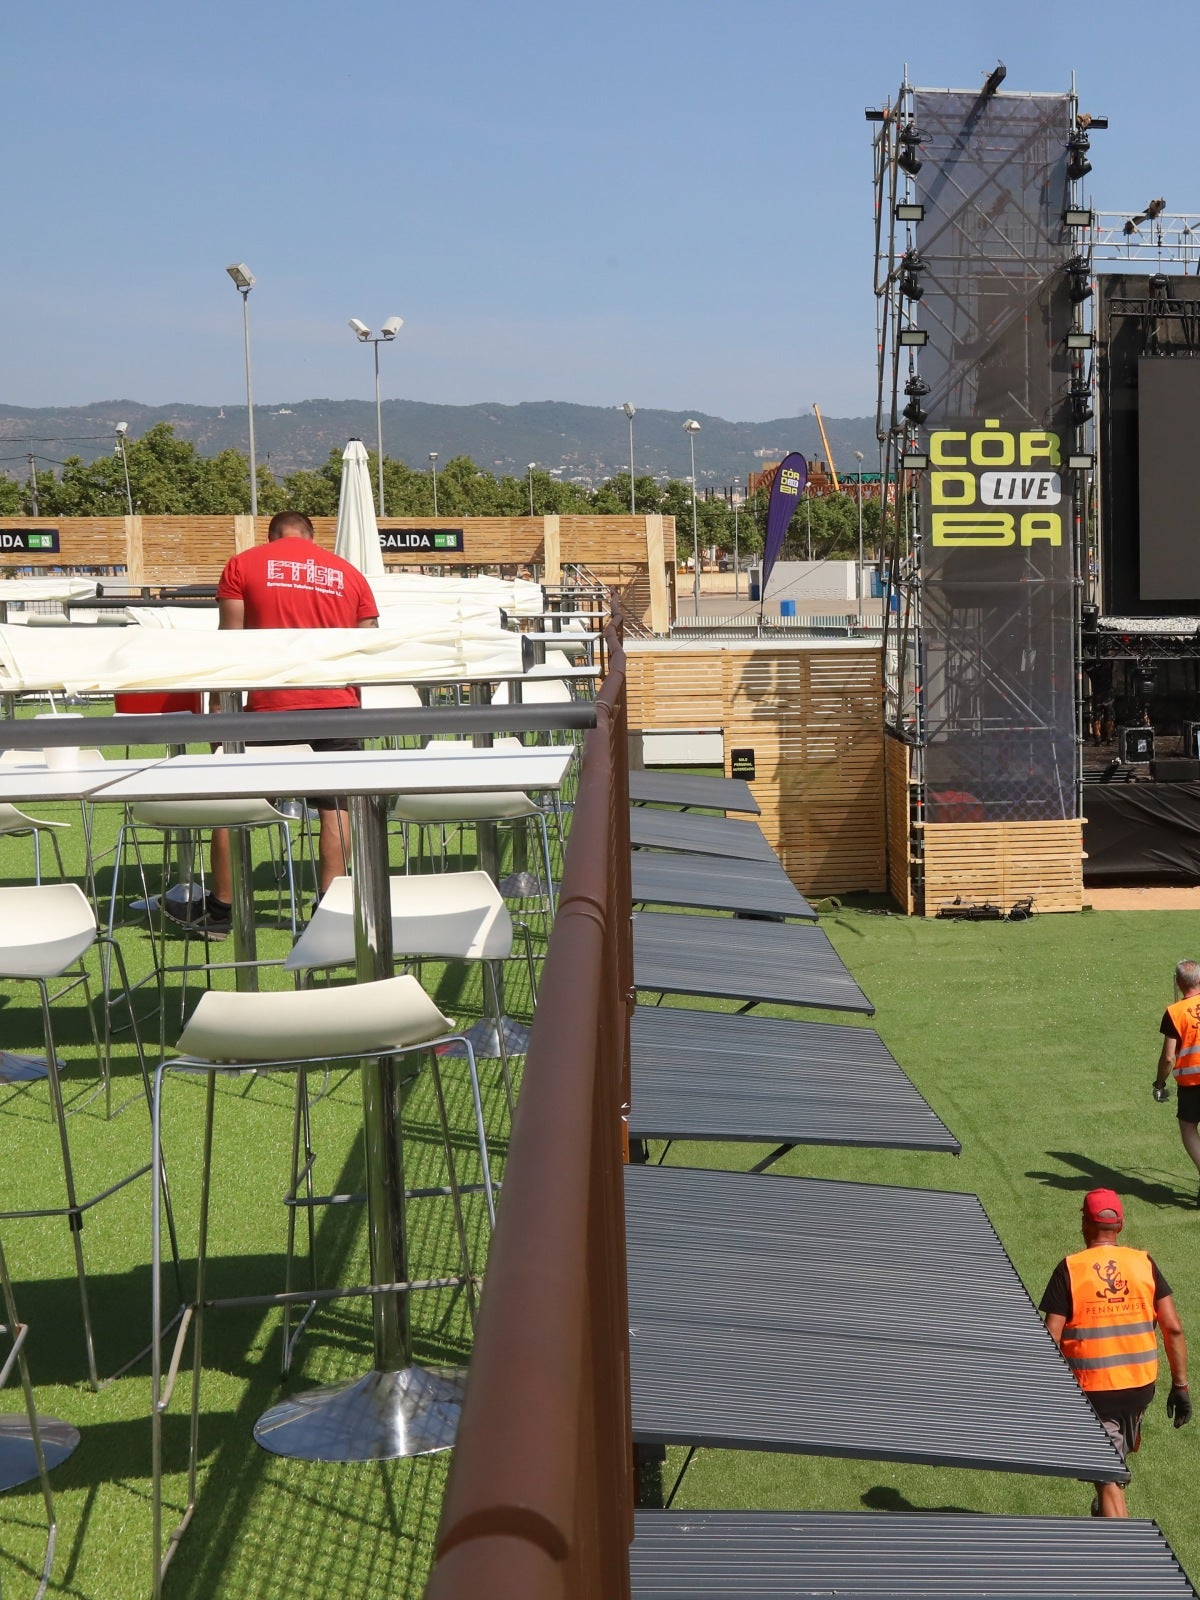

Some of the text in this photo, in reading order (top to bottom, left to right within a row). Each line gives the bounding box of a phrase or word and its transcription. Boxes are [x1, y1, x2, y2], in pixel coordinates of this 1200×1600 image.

[993, 478, 1050, 500] LIVE
[932, 512, 1062, 547] BA
[379, 534, 431, 547] SALIDA
[1085, 1302, 1146, 1315] PENNYWISE
